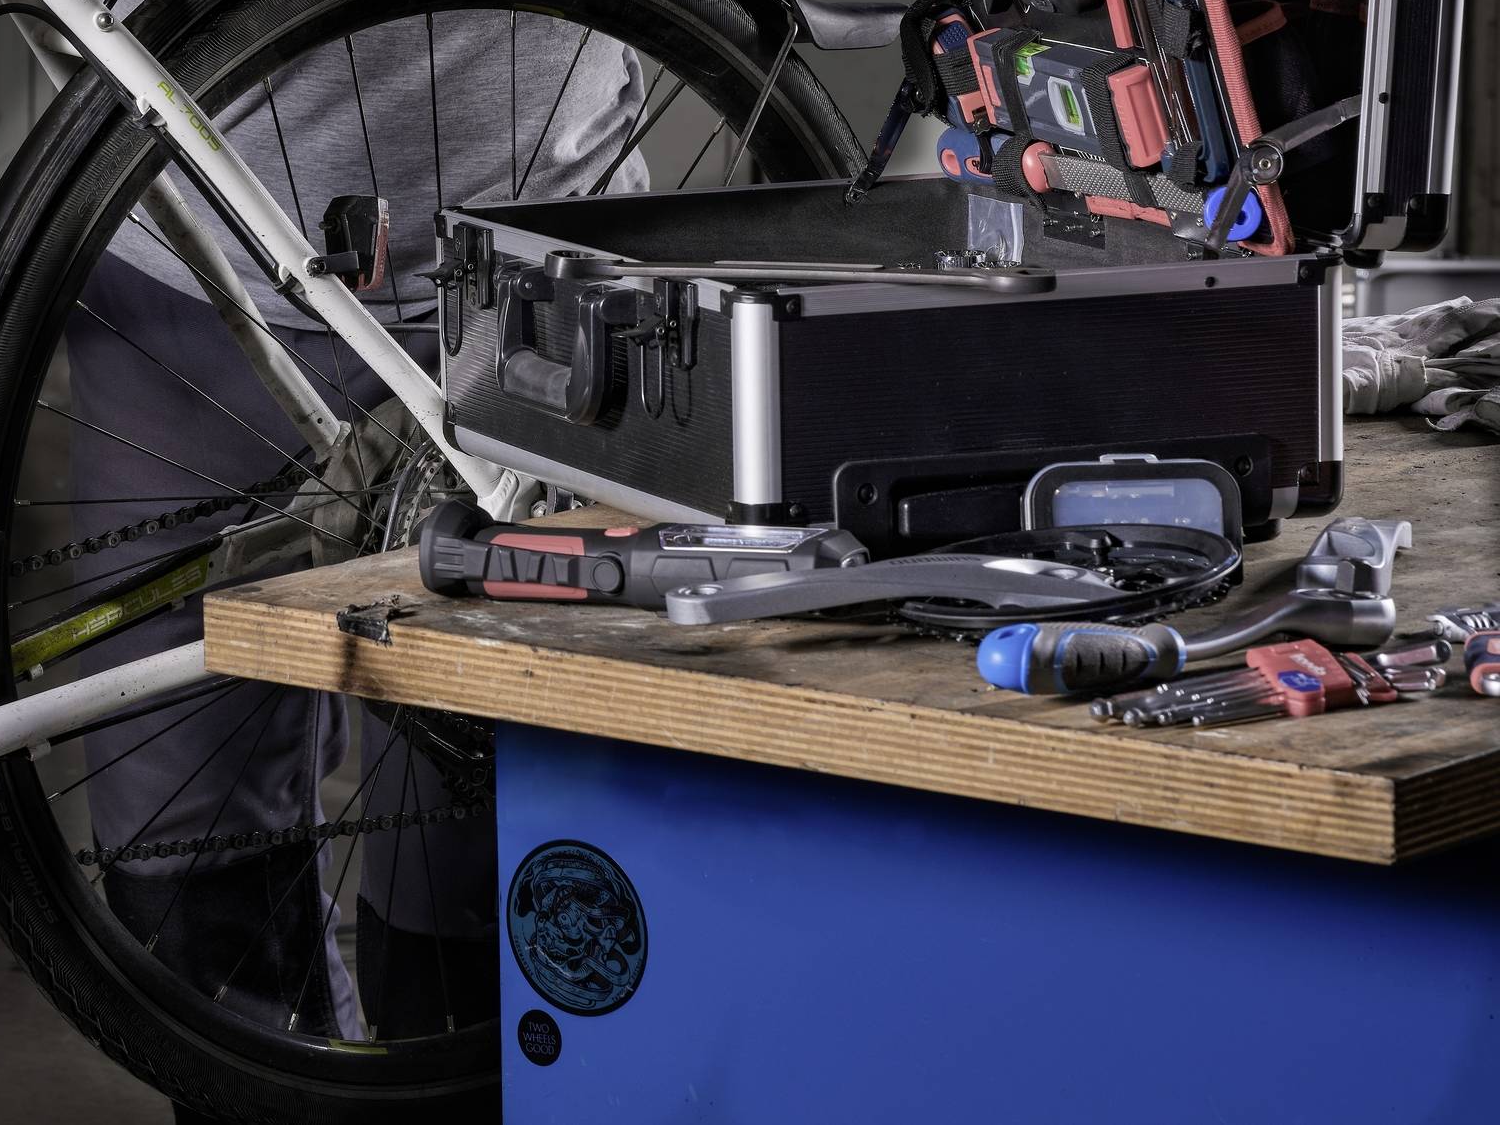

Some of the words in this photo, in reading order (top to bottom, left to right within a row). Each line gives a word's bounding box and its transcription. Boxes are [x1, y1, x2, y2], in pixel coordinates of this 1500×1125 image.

[529, 1021, 550, 1033] TWO
[522, 1031, 556, 1045] WHEELS
[525, 1042, 555, 1055] GOOD
